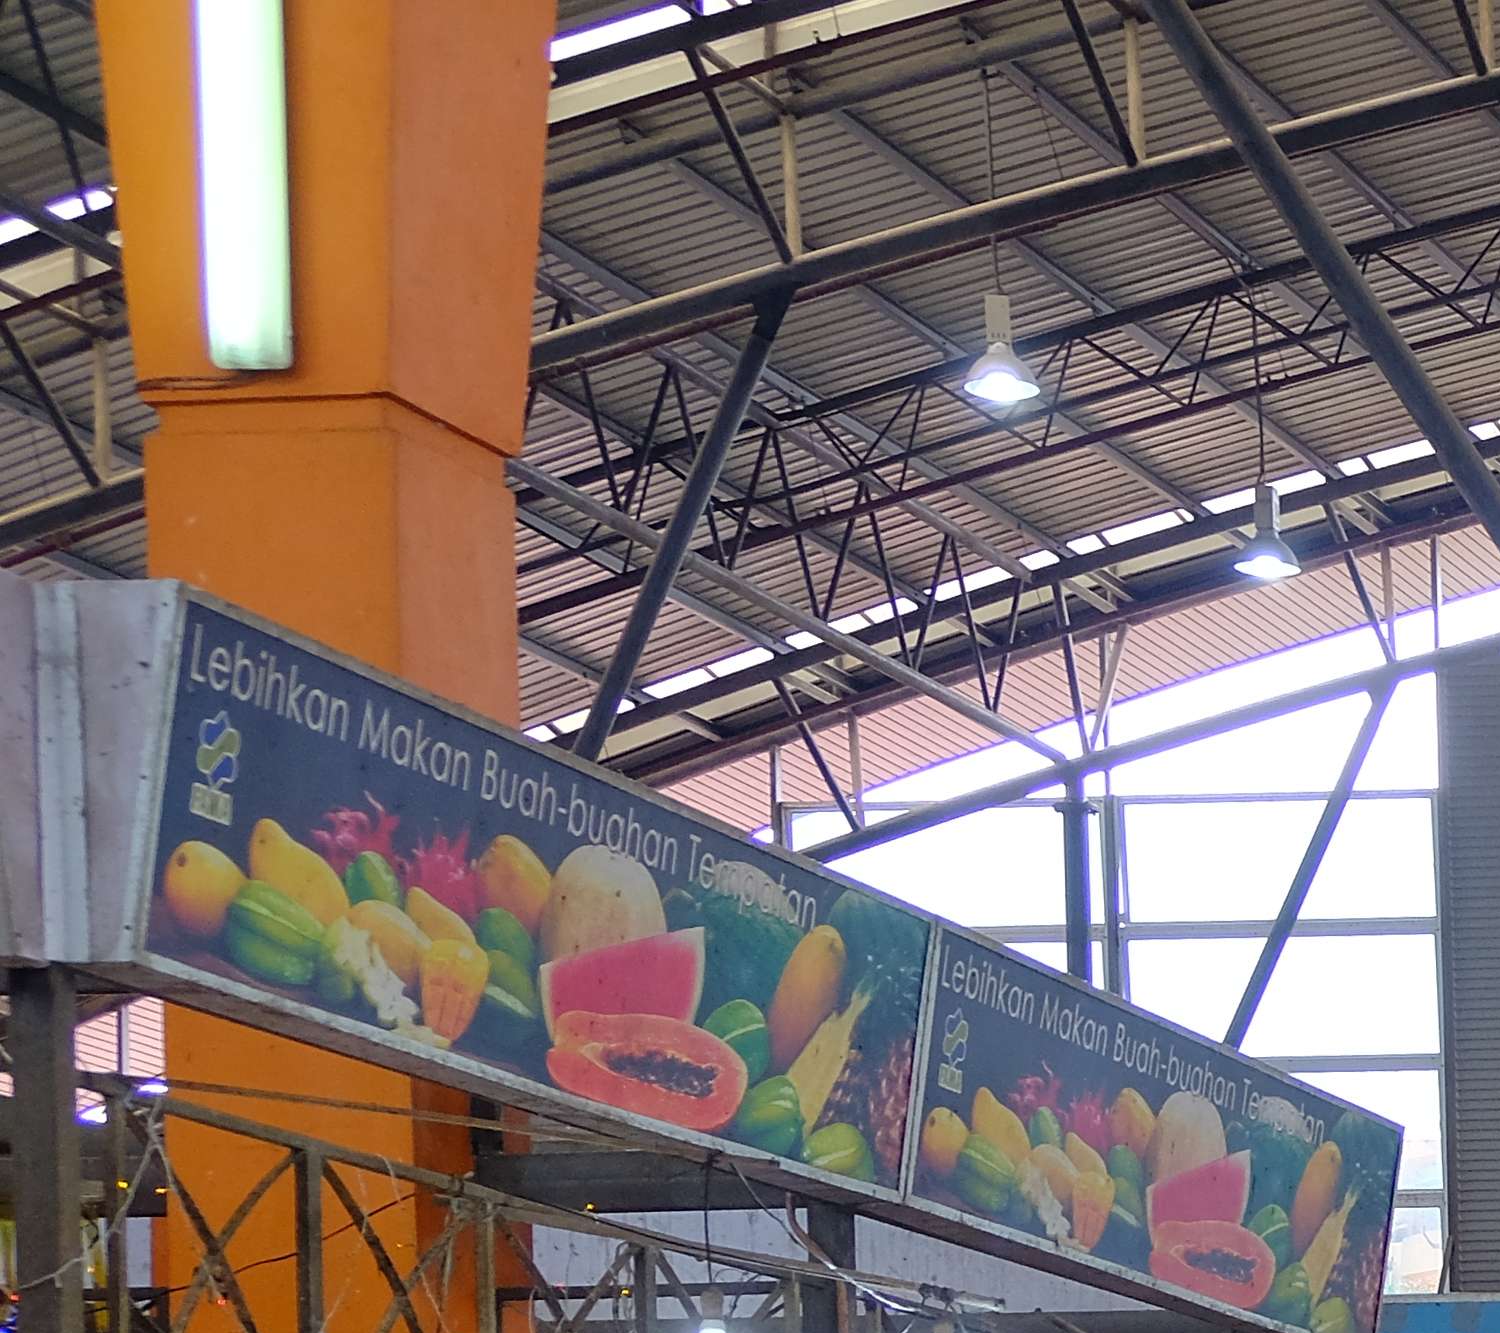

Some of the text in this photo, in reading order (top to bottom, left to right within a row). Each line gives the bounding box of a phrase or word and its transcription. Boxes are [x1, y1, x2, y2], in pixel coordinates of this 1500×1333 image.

[190, 625, 817, 931] Lebihkan Makan Buah-buahan Tempatan
[942, 944, 1035, 1025] Lebihkan
[1039, 993, 1108, 1058] Makan
[1113, 1022, 1239, 1106] Buah-buahan
